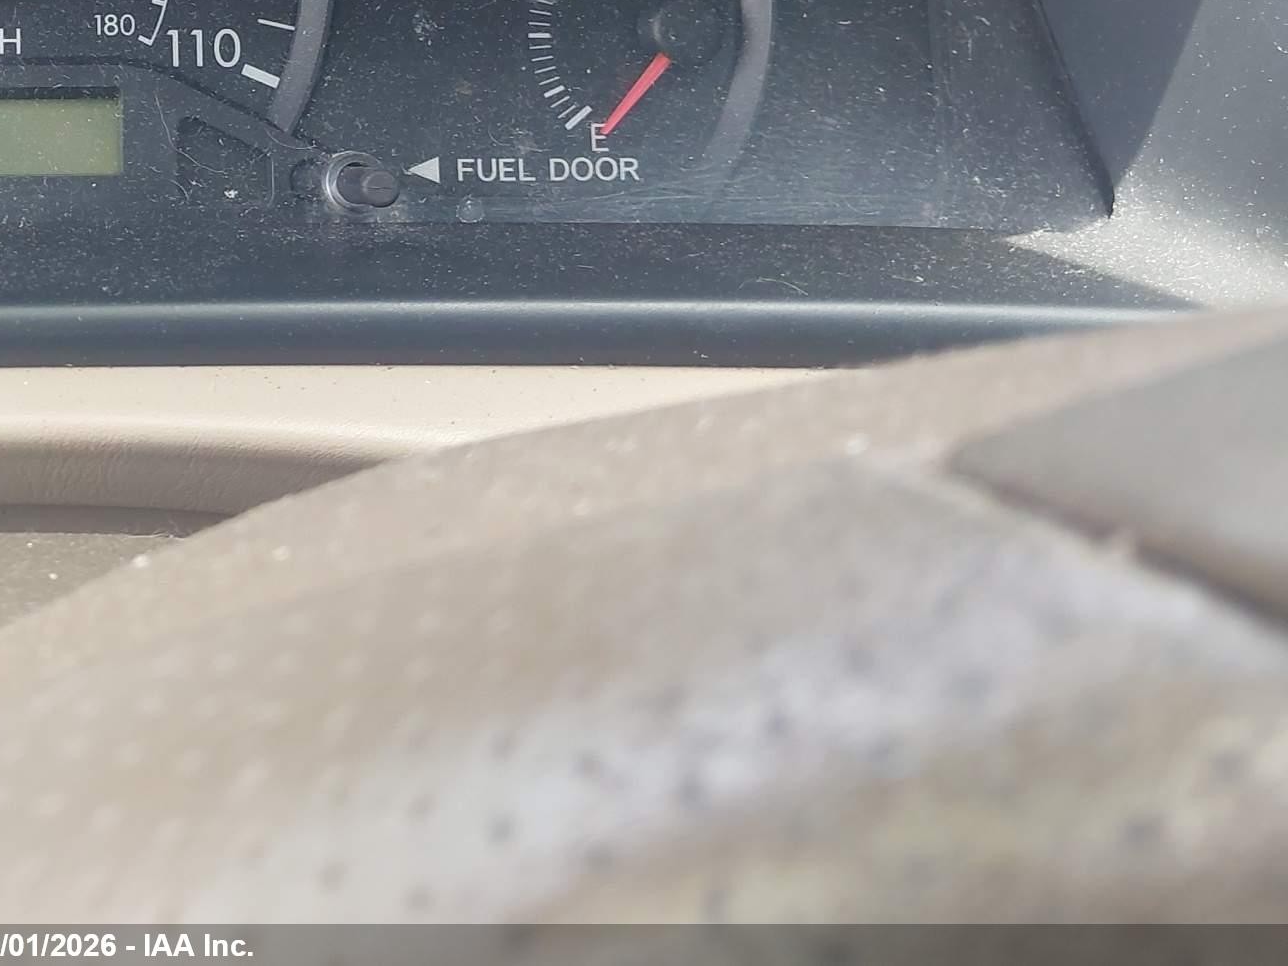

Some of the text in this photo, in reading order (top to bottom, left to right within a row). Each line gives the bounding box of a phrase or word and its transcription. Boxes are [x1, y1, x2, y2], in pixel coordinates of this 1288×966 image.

[94, 14, 136, 36] 180
[166, 28, 241, 68] 110
[590, 122, 611, 152] E
[456, 157, 640, 182] FUEL DOOR
